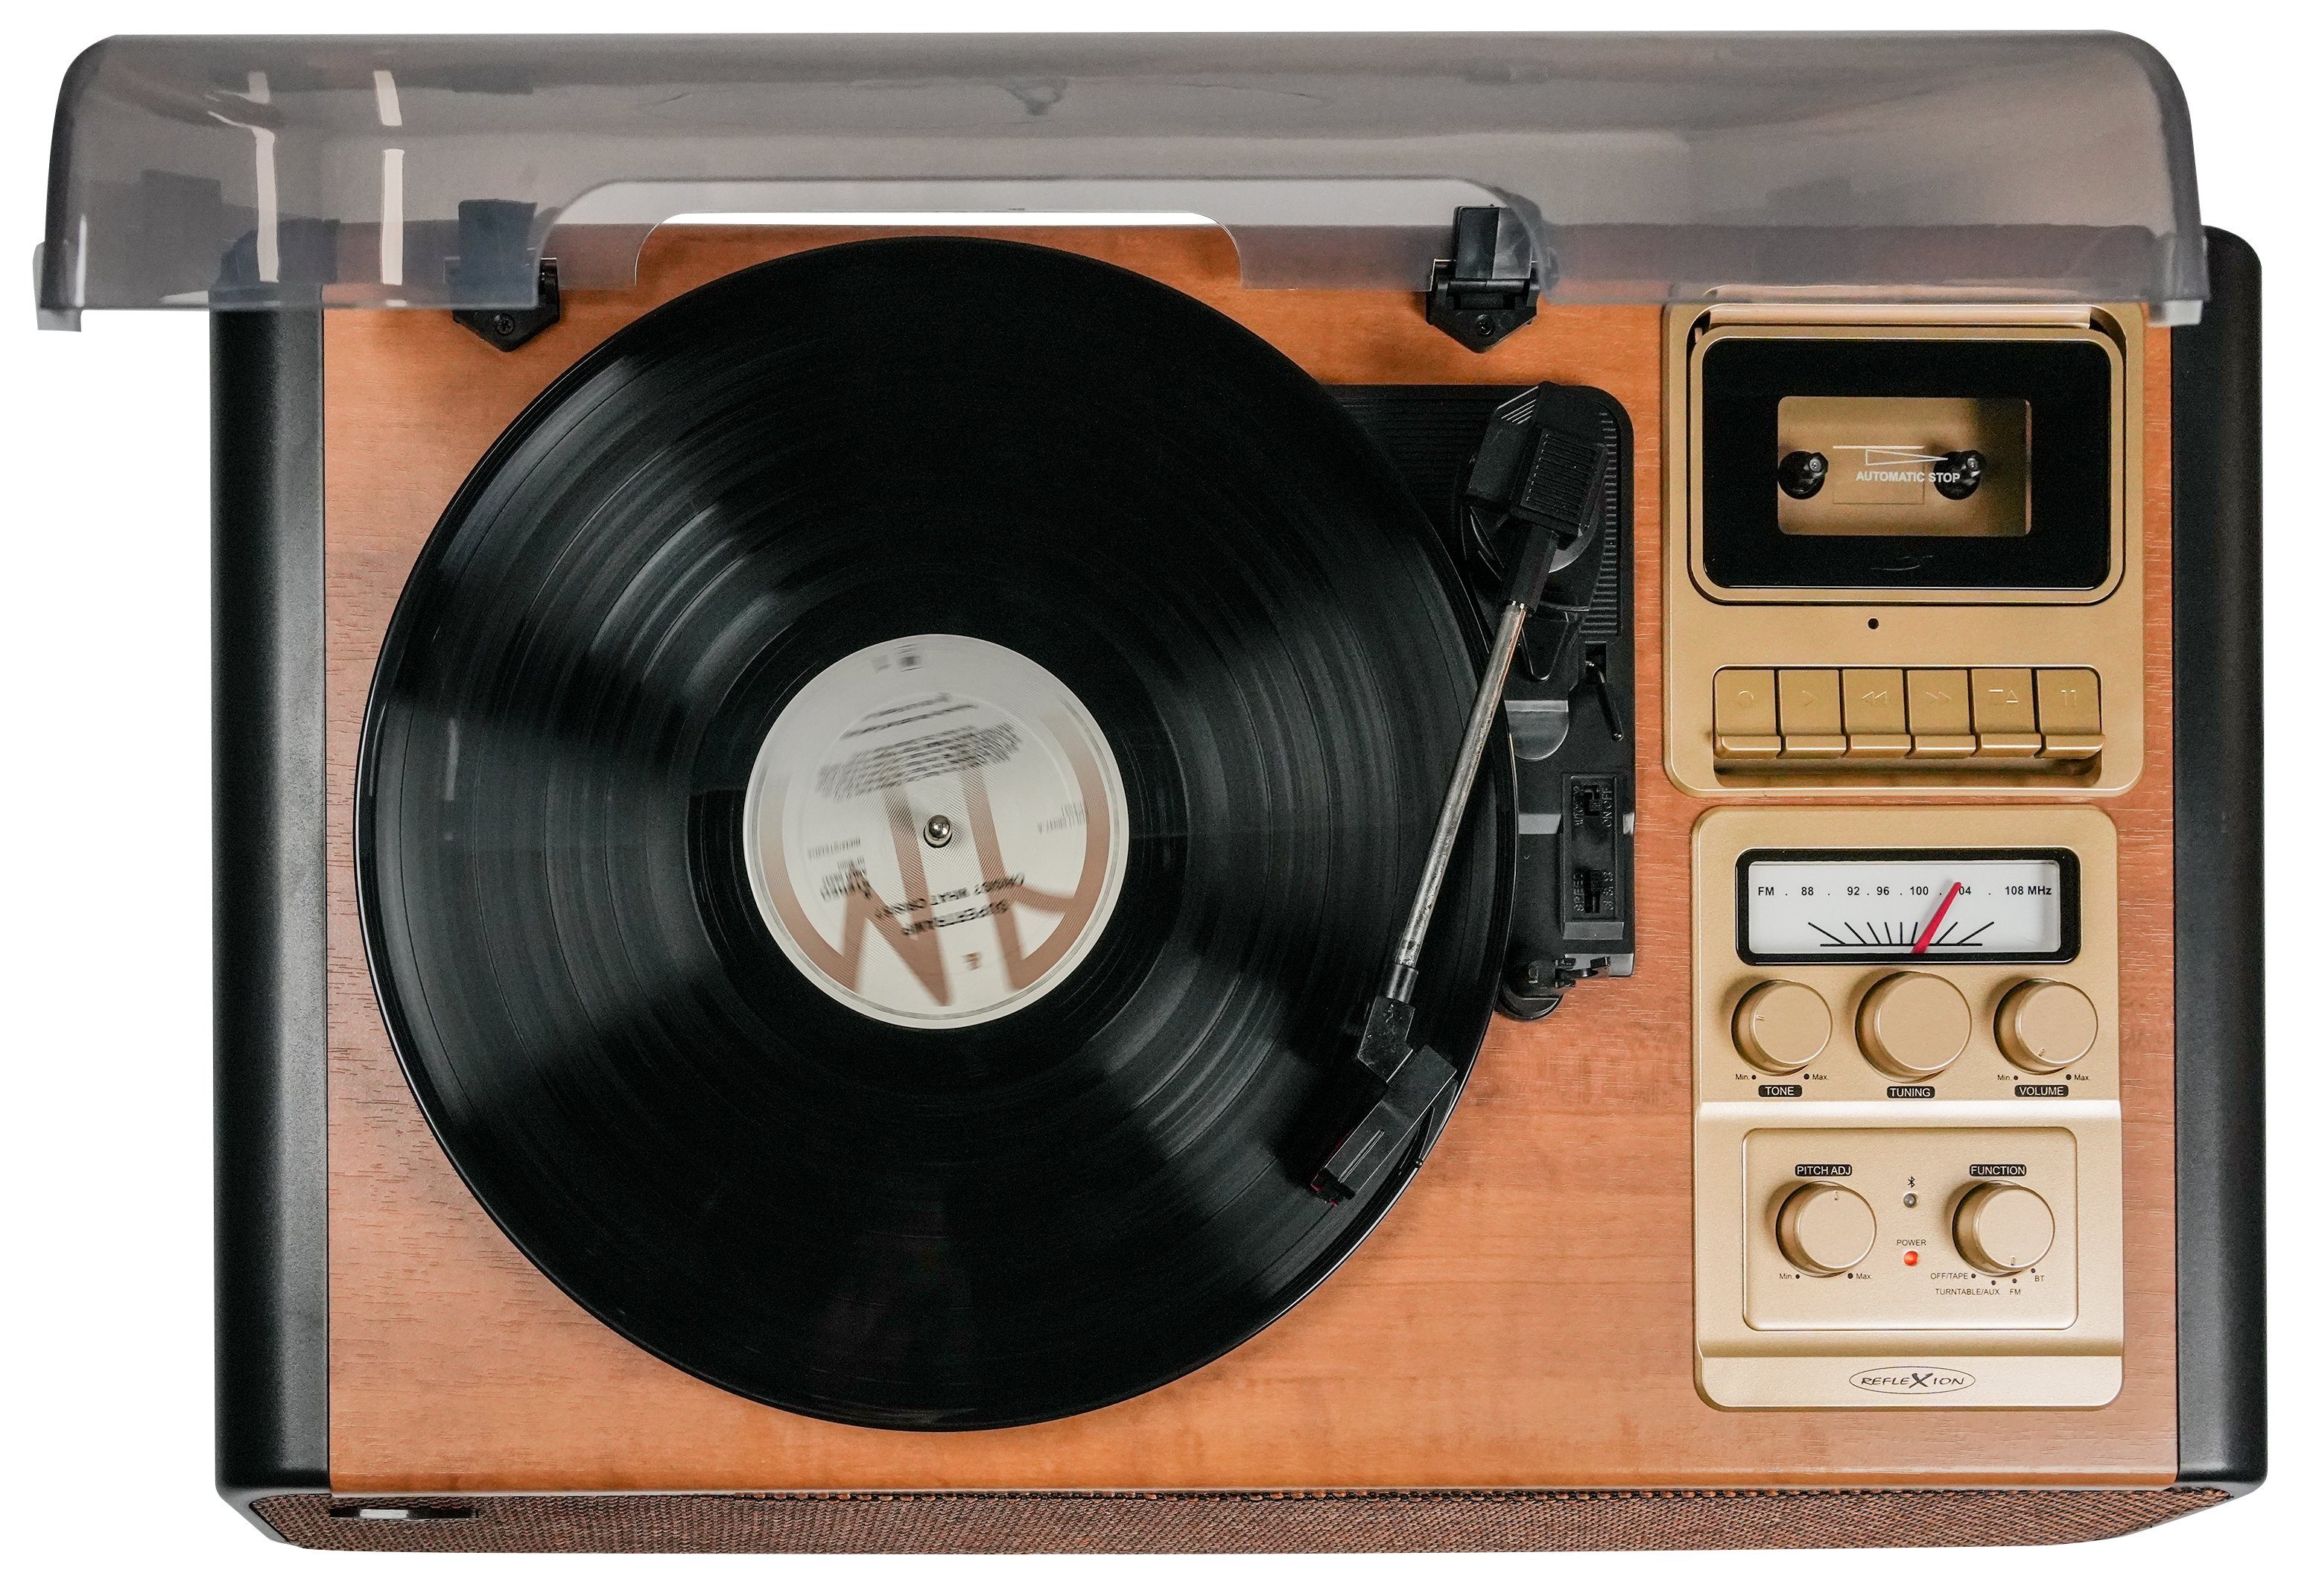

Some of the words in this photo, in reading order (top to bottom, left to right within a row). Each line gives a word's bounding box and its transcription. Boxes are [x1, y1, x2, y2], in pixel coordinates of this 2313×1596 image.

[1855, 471, 1926, 483] AUTOMATIC
[1928, 471, 1961, 483] STOP
[1758, 886, 1774, 896] FM
[1801, 886, 1814, 896] 88
[1847, 886, 1860, 896] 92
[1876, 886, 1890, 896] 96
[1909, 886, 1929, 896] 100
[1958, 886, 1972, 895] 04
[2005, 886, 2024, 895] 108
[2028, 886, 2052, 895] MHz
[1765, 1087, 1795, 1096] TONE
[1890, 1088, 1931, 1097] TUNING
[2019, 1087, 2064, 1096] VOLUME
[1797, 1166, 1829, 1175] PITCH
[1830, 1166, 1851, 1175] ADJ
[1970, 1166, 2025, 1175] FUNCTION
[1896, 1239, 1926, 1247] POWER
[1930, 1272, 1969, 1280] OFF/TAPE
[2034, 1274, 2045, 1282] BT
[1935, 1288, 2000, 1296] TURNTABLE/AUX
